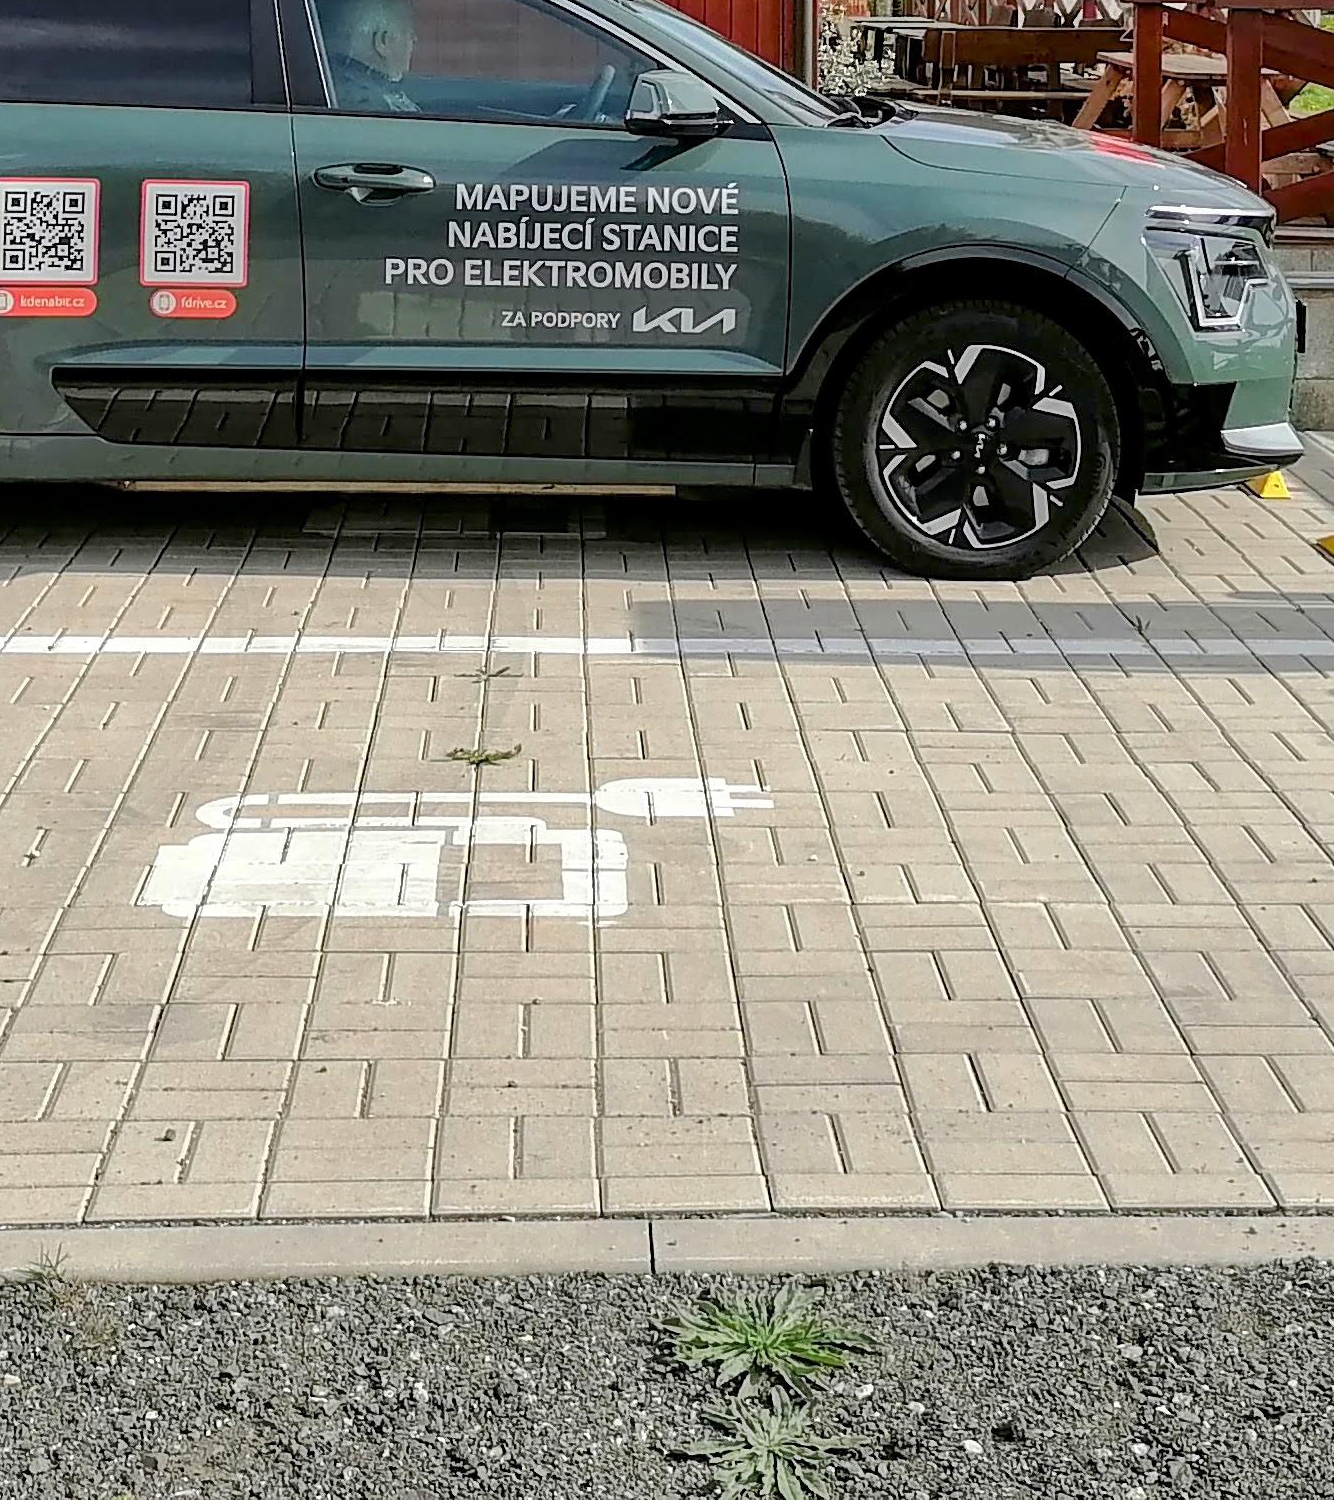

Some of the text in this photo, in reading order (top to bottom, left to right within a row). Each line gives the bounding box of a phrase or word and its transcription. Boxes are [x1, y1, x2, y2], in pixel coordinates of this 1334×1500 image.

[455, 182, 740, 215] MAPUJEME NOVÉ
[447, 216, 740, 253] NABÍJECÍ STANICE
[384, 258, 739, 290] PRO ELEKTROMOBILY
[500, 310, 527, 328] ZA
[530, 311, 621, 329] PODPORY
